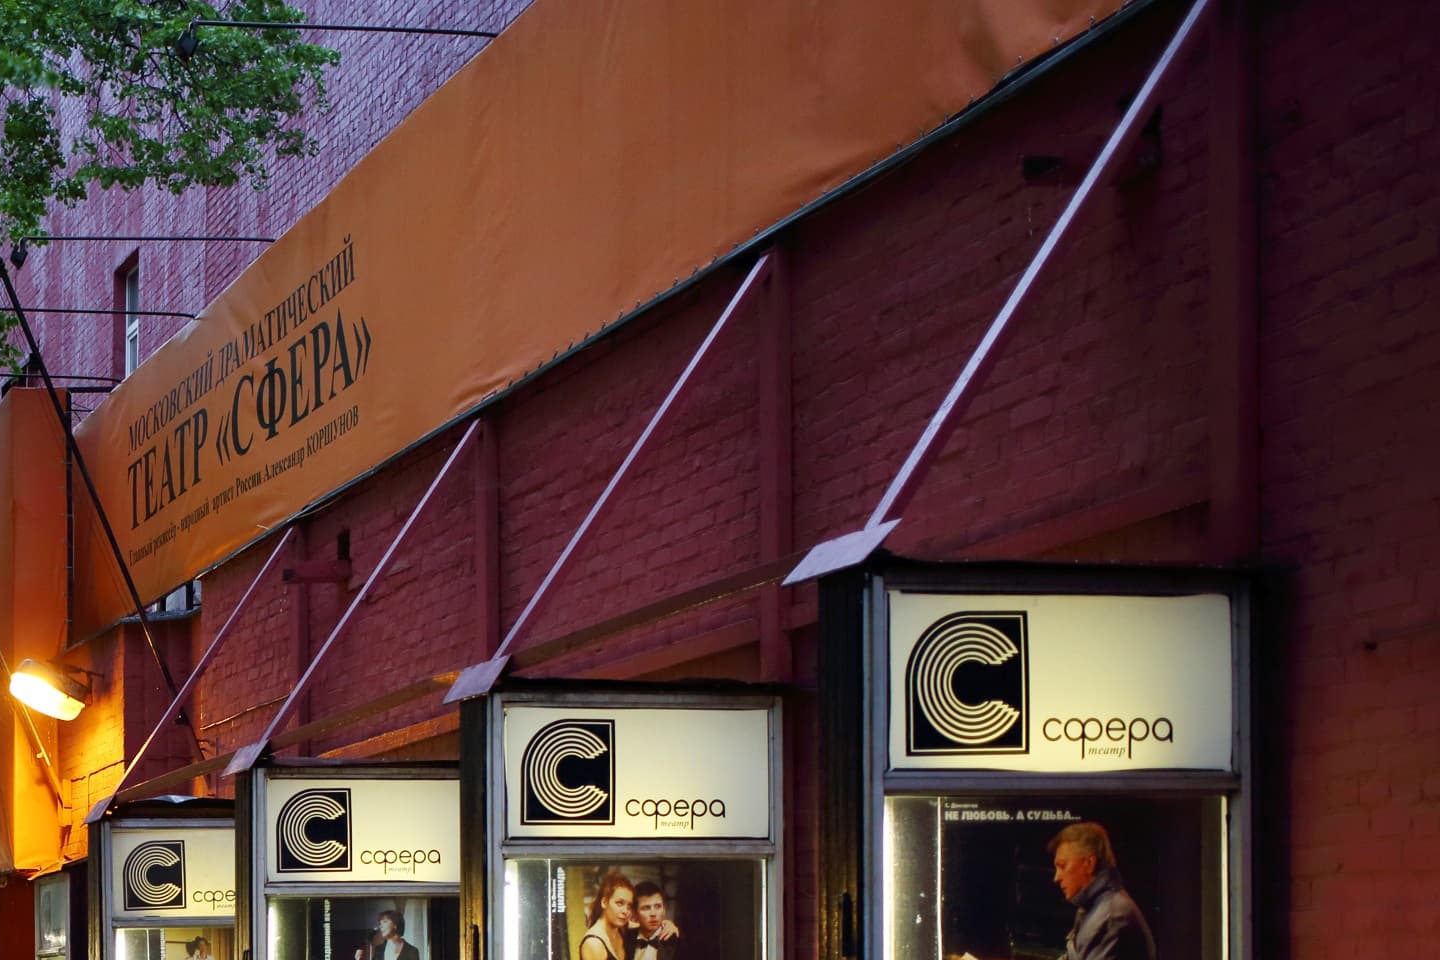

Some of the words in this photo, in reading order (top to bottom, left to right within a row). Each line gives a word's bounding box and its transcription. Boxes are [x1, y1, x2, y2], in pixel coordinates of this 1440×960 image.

[128, 352, 212, 455] МОСКОВСКИЙ
[128, 409, 208, 530] ТЕАТР
[216, 308, 371, 466] «СФЕРА»
[236, 472, 262, 497] России
[264, 447, 305, 482] Александр
[307, 405, 359, 458] КОРШУНОВ
[944, 811, 959, 821] НЕ
[1016, 811, 1025, 820] А
[193, 890, 236, 911] сфе
